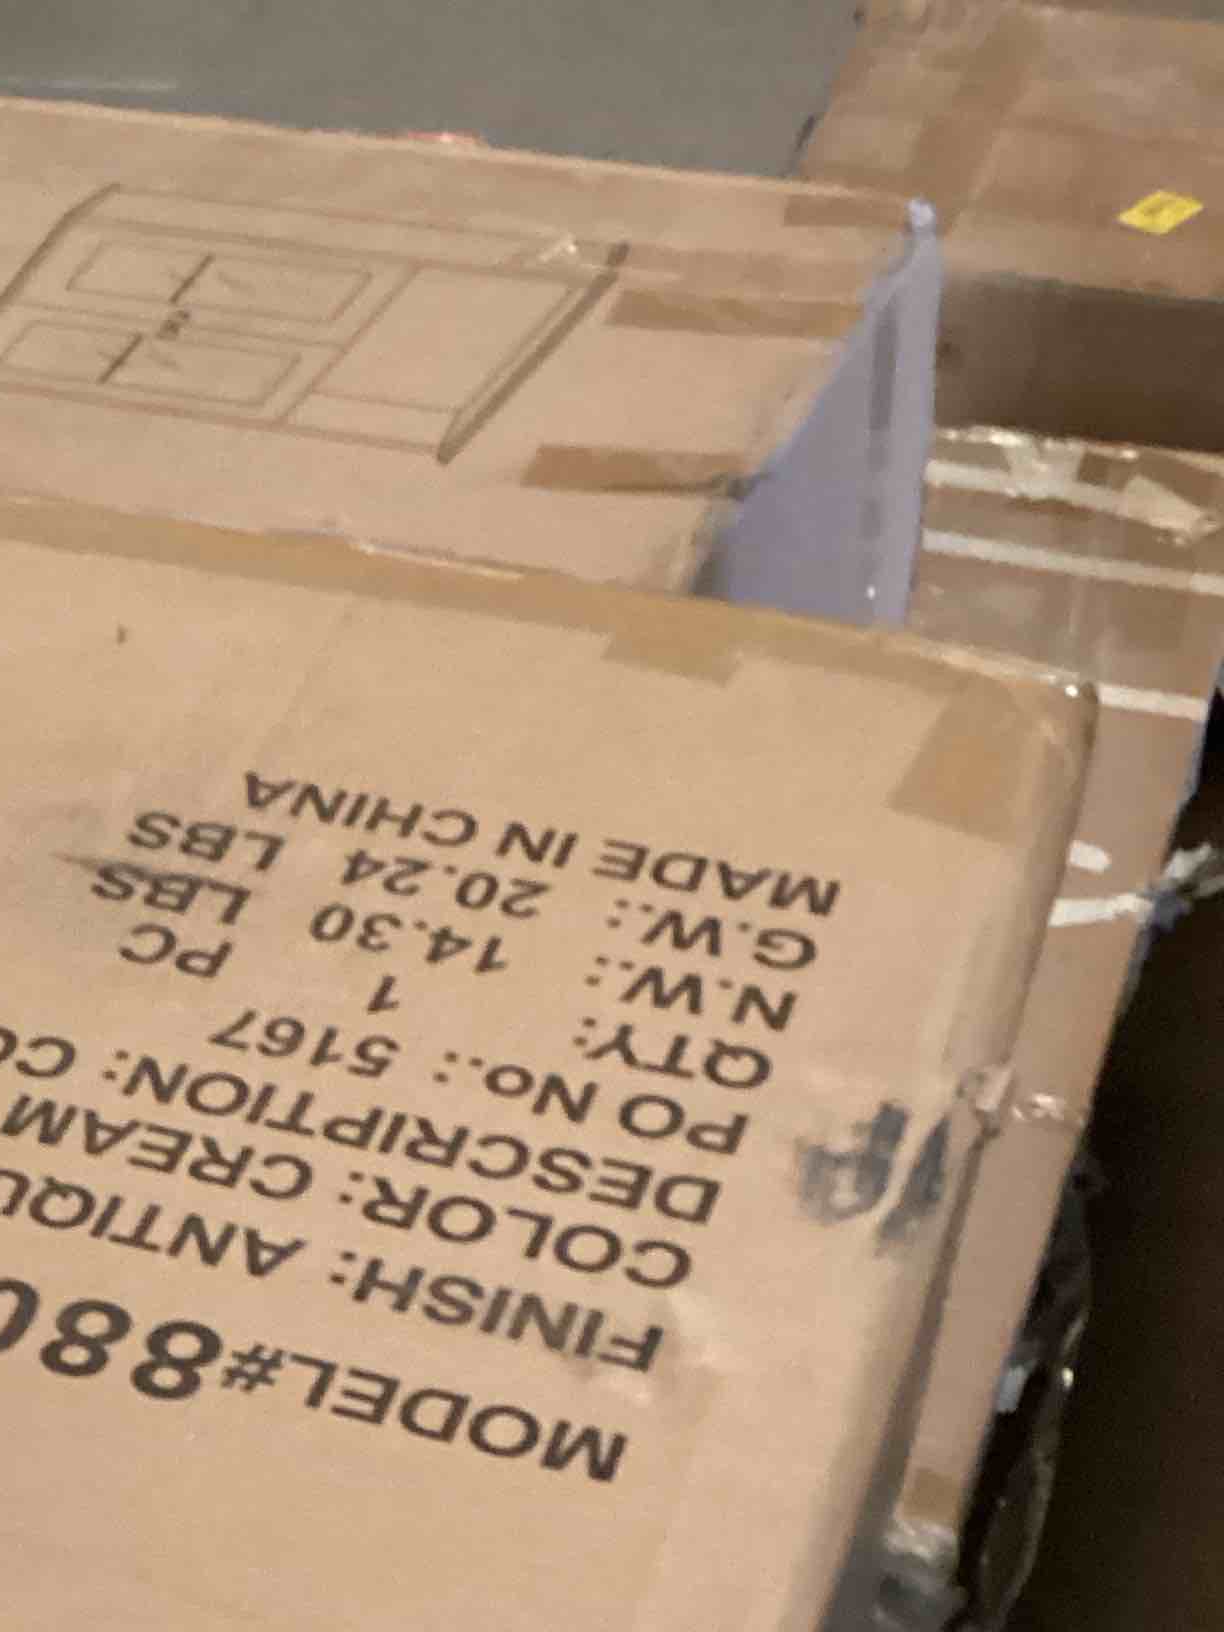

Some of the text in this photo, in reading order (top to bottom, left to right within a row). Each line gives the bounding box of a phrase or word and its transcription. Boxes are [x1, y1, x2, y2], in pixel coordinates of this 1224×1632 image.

[126, 810, 819, 971] G.W.: 20.24 LBS
[243, 770, 840, 917] MADE IN CHINA
[90, 861, 798, 1032] N.W.: 14.30 LBS
[117, 923, 774, 1091] QTY: 1 PC
[208, 1007, 402, 1079] 5167
[102, 1048, 723, 1226] DESCRIPTION:
[618, 1094, 750, 1156] PO
[338, 1170, 693, 1290] COLOR:
[329, 1250, 665, 1374] FINISH:
